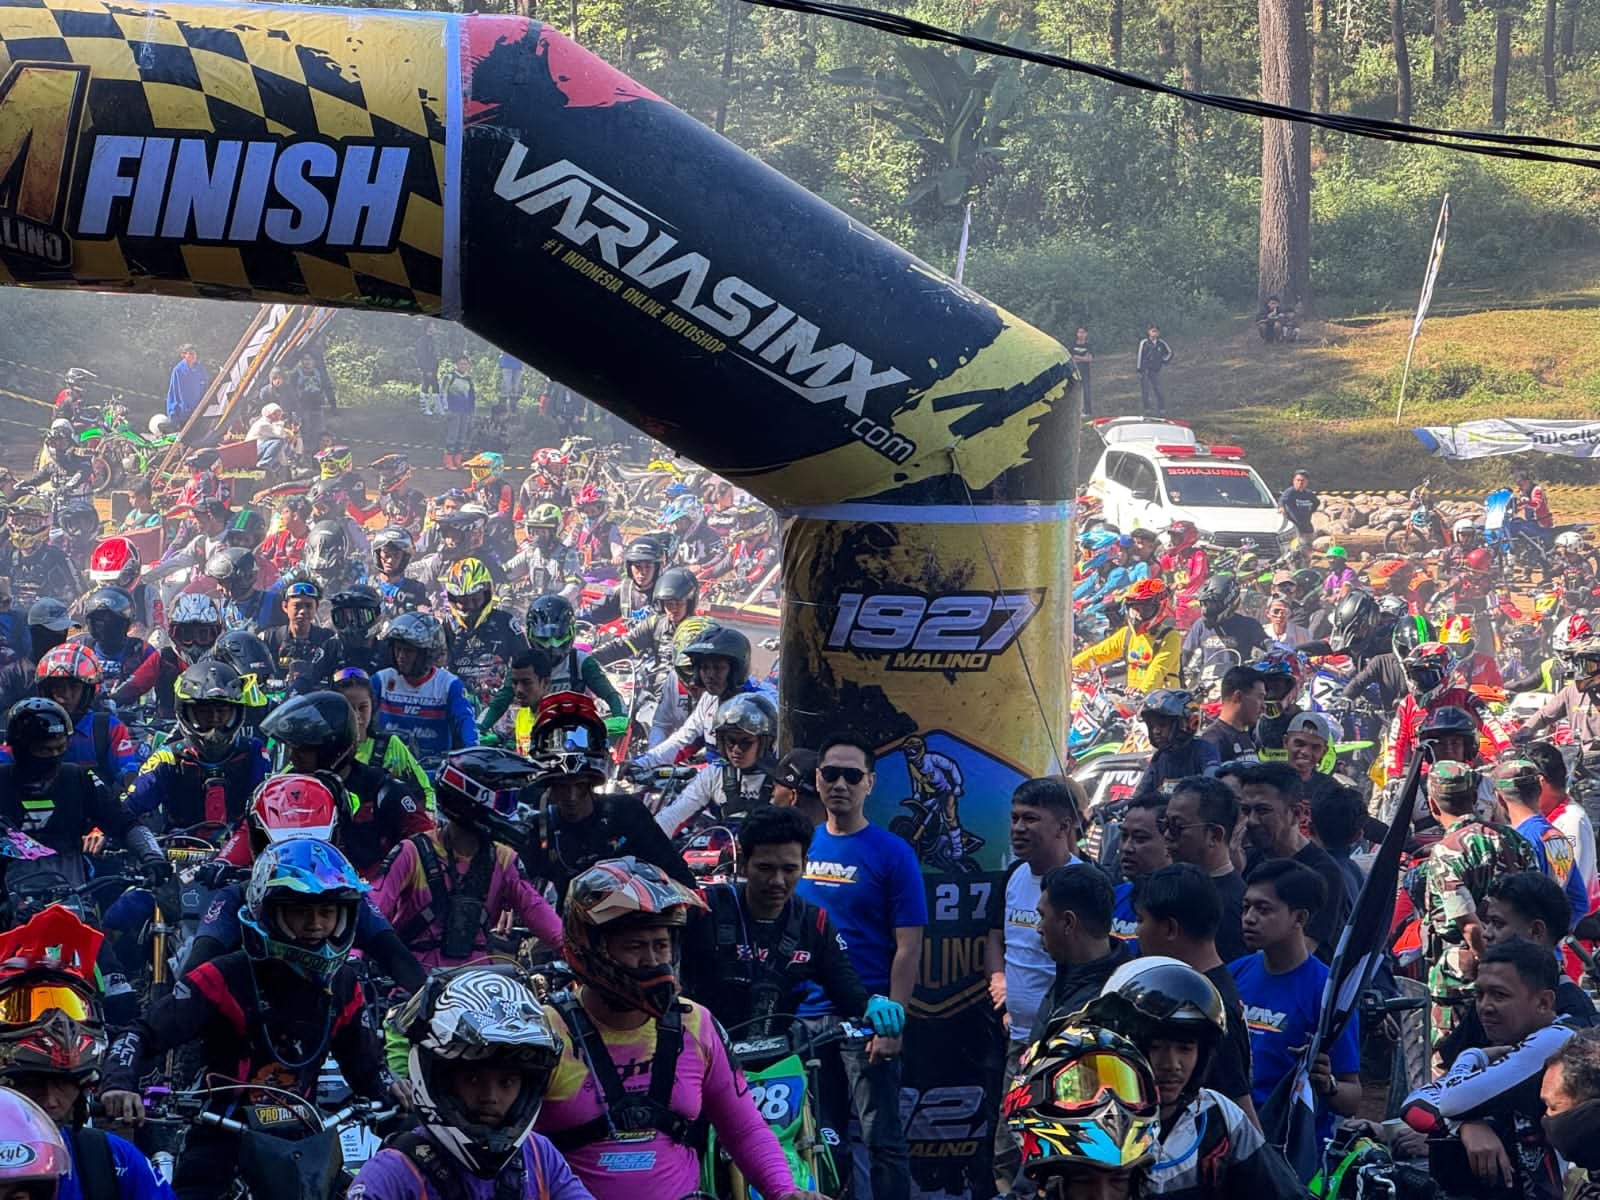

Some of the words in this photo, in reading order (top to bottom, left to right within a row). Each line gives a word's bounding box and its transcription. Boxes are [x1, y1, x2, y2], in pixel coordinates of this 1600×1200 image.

[77, 134, 410, 247] FINISH
[0, 216, 62, 261] LINO
[493, 140, 912, 417] VARIASIMX
[541, 238, 565, 256] #1
[561, 249, 625, 294] INDONESIA
[621, 287, 667, 319] ONLINE
[661, 311, 727, 354] MOTOSHOP
[827, 592, 1040, 651] 1927
[894, 653, 986, 669] MALINO
[909, 1142, 978, 1157] ALINO
